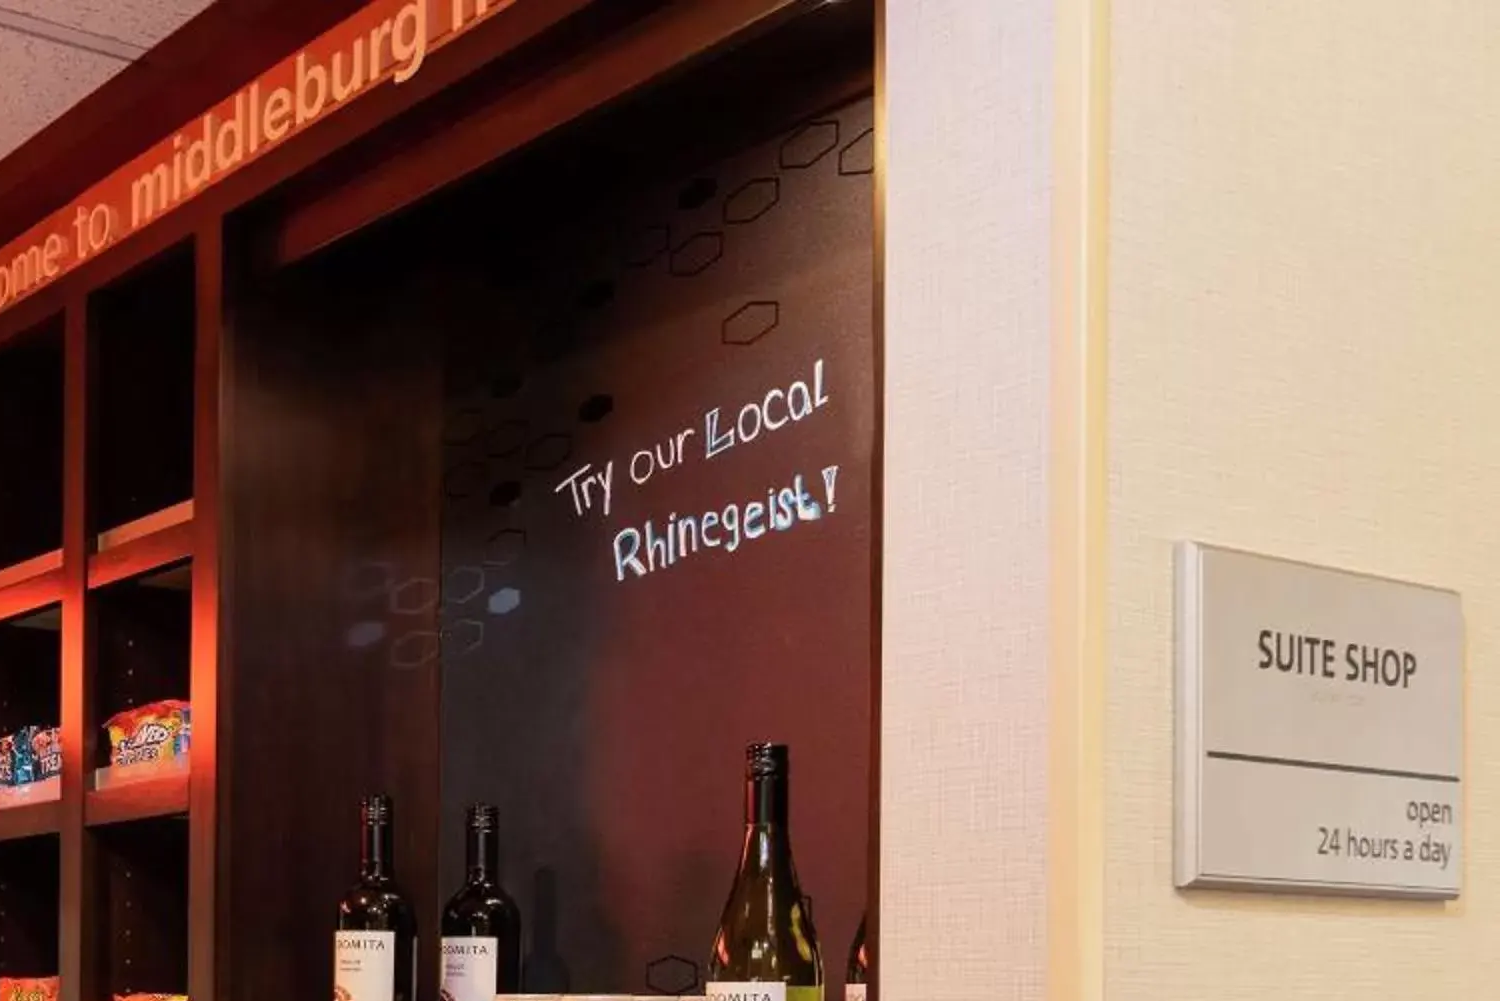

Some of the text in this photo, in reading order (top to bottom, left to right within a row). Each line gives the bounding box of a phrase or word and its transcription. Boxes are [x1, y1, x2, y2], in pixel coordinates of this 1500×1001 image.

[72, 202, 112, 261] to
[129, 0, 427, 229] middleburg
[554, 461, 613, 517] Try
[629, 428, 695, 486] our
[1258, 629, 1417, 689] SUITE SHOP
[1406, 800, 1453, 829] open
[1317, 826, 1453, 870] 24 hours a day
